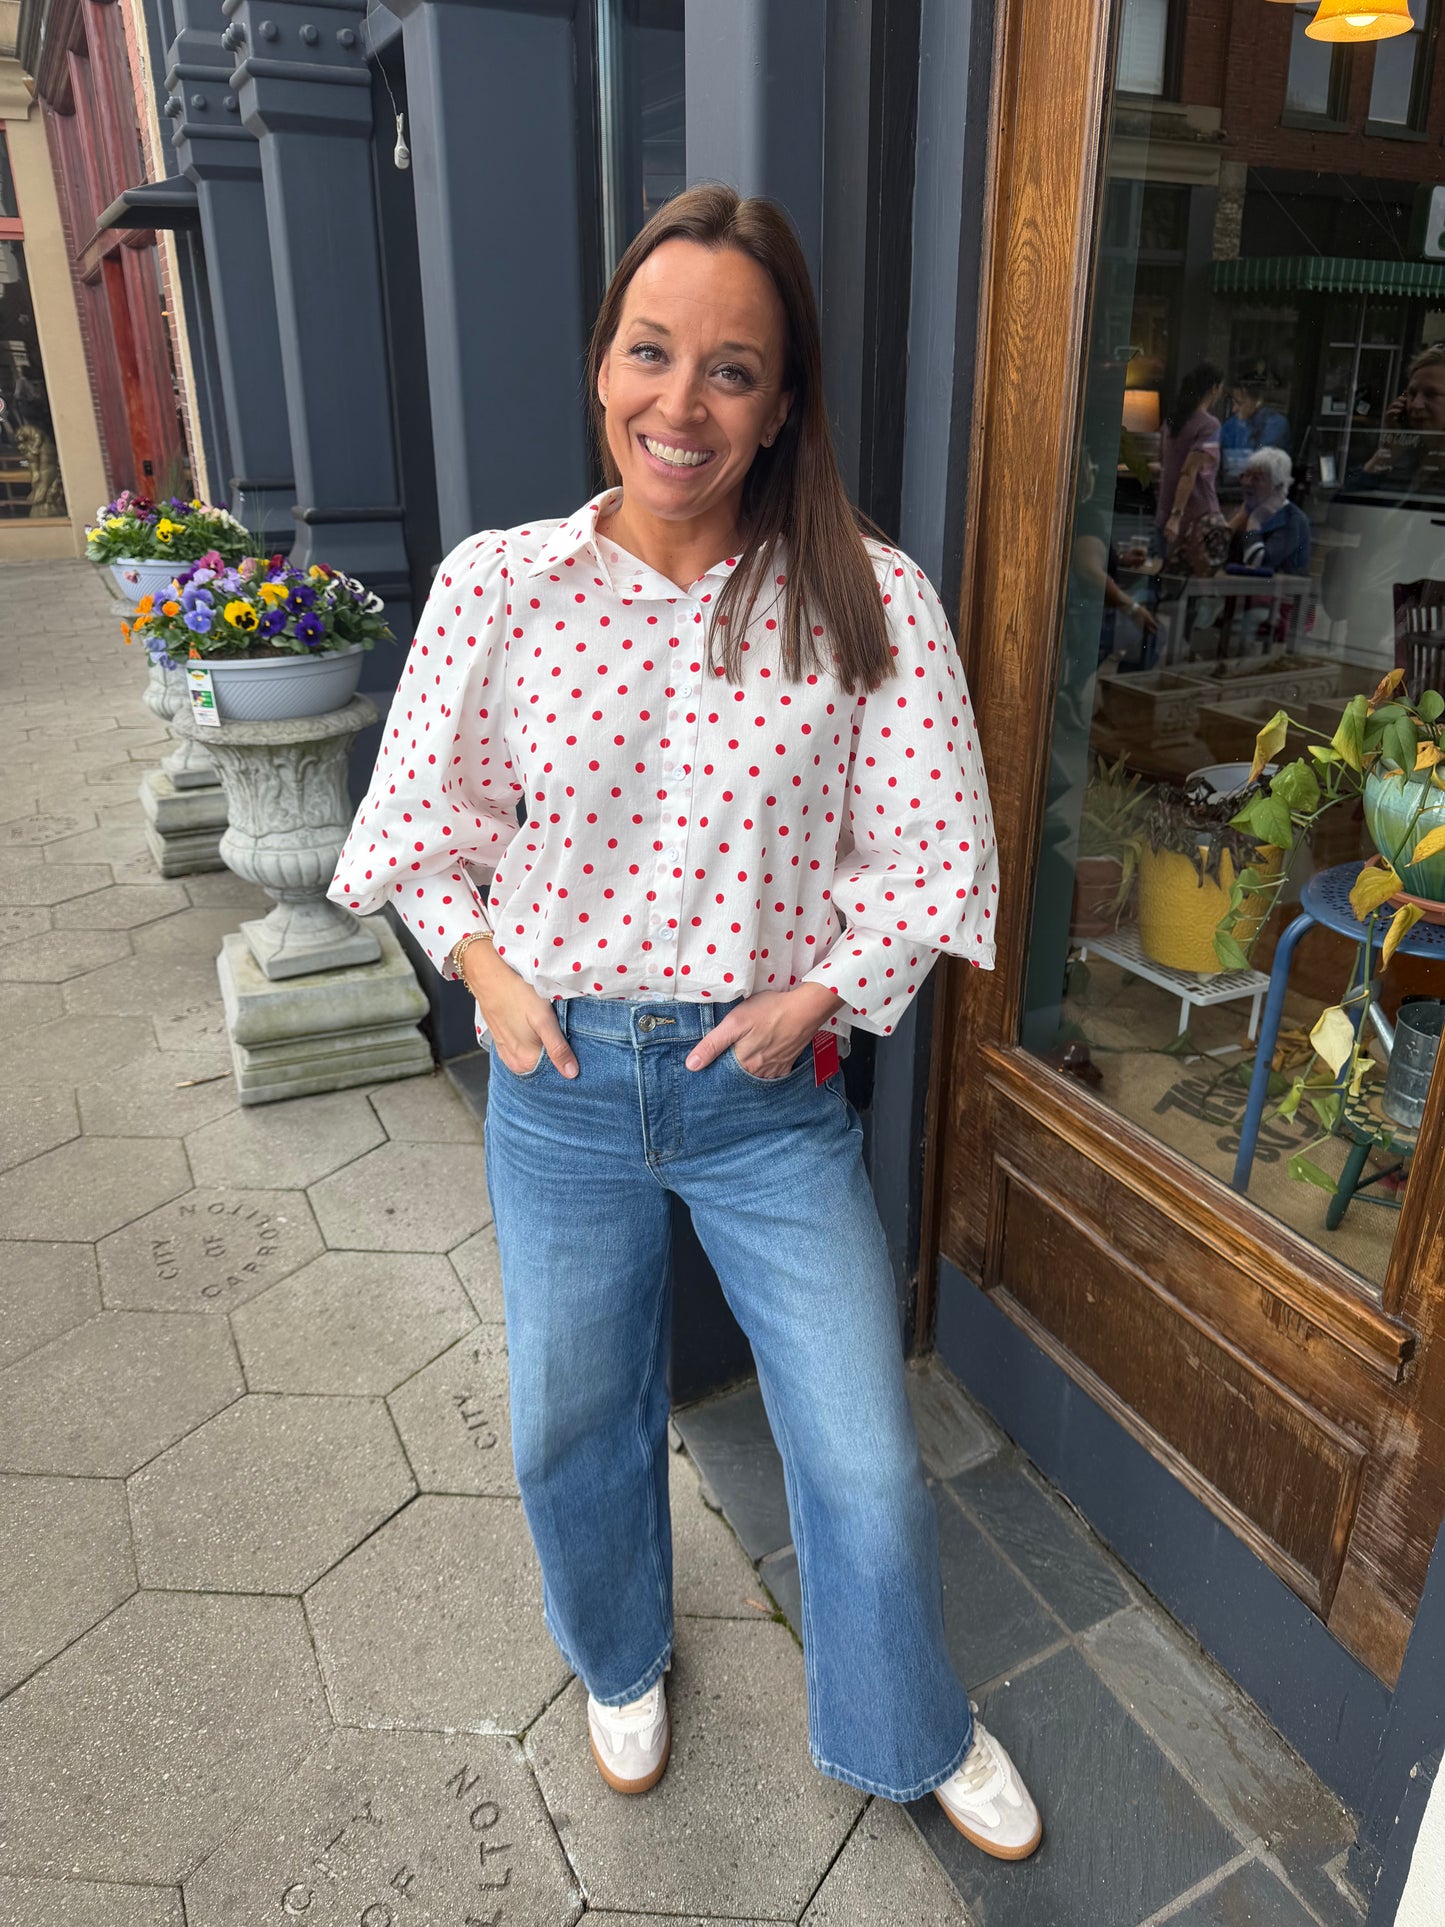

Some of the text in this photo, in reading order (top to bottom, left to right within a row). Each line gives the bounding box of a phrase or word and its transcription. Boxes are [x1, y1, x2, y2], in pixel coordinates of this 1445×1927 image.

[152, 1238, 179, 1280] CITY
[203, 1236, 227, 1258] OF
[452, 1395, 498, 1450] CITY
[445, 1763, 513, 1927] LLTON
